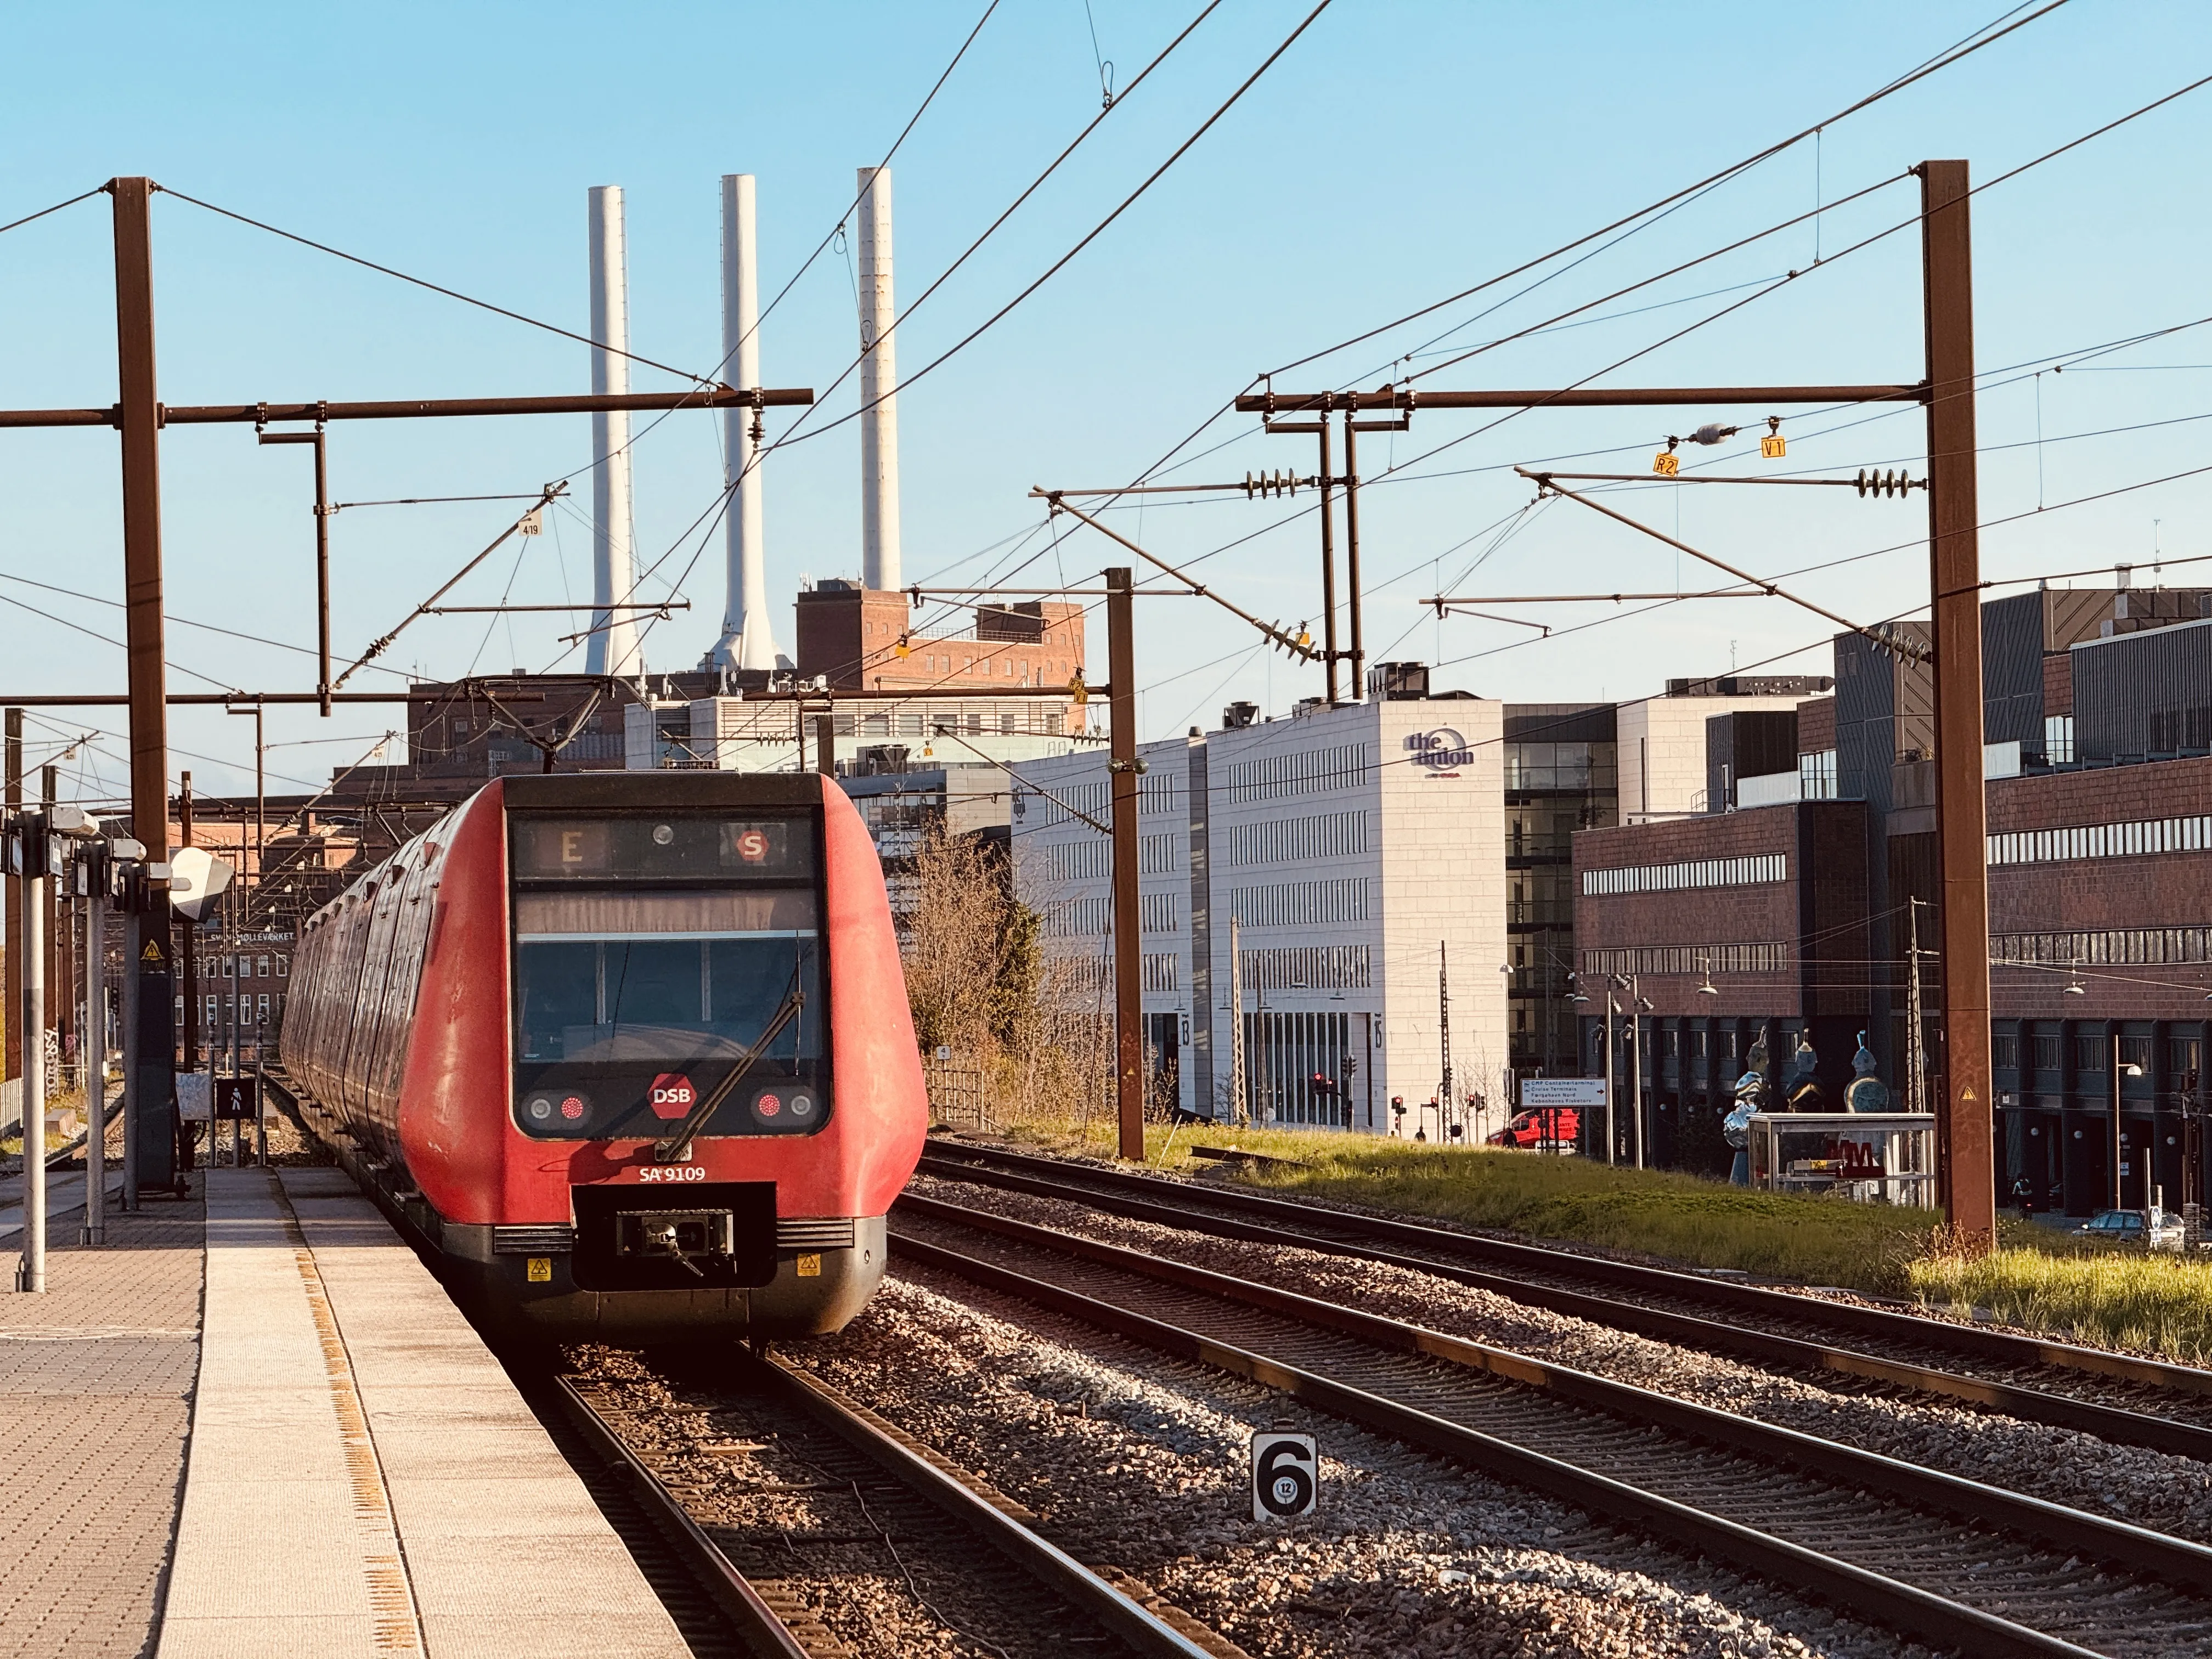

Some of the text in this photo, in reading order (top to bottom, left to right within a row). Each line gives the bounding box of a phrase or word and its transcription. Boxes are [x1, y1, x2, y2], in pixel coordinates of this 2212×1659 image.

[1657, 458, 1674, 474] R2
[1070, 680, 1081, 690] R2
[1407, 732, 1442, 750] the
[1415, 747, 1474, 765] union
[562, 831, 583, 862] E
[744, 836, 762, 856] S
[653, 1088, 691, 1103] DSB
[640, 1167, 706, 1182] SA 9109
[1257, 1441, 1313, 1516] 6
[1280, 1483, 1291, 1493] 12
